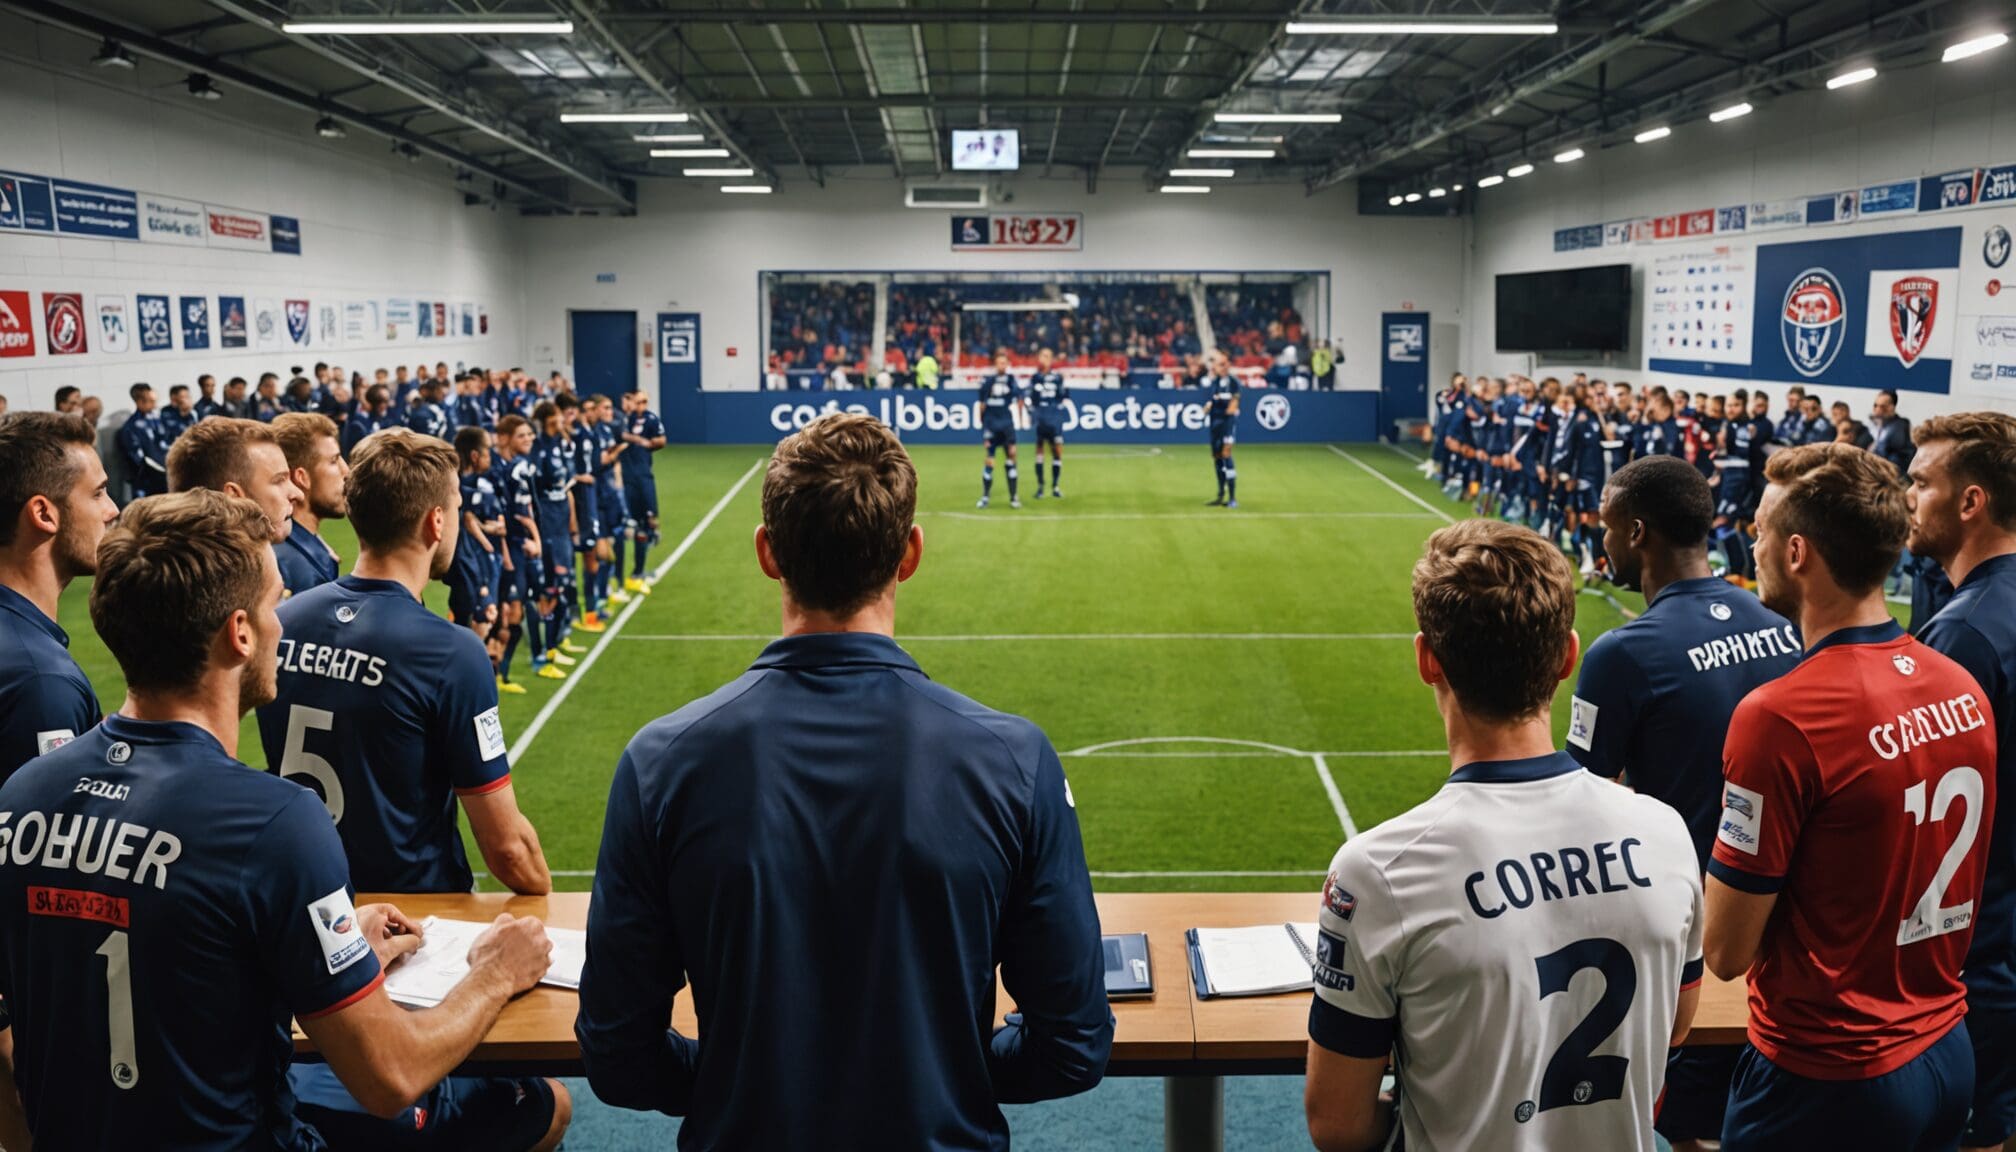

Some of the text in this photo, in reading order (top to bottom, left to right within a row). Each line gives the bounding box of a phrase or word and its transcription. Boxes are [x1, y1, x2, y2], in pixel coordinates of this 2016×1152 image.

[279, 703, 345, 827] 5
[1464, 837, 1652, 920] CORREC
[95, 929, 140, 1090] 1
[1534, 937, 1638, 1113] 2
